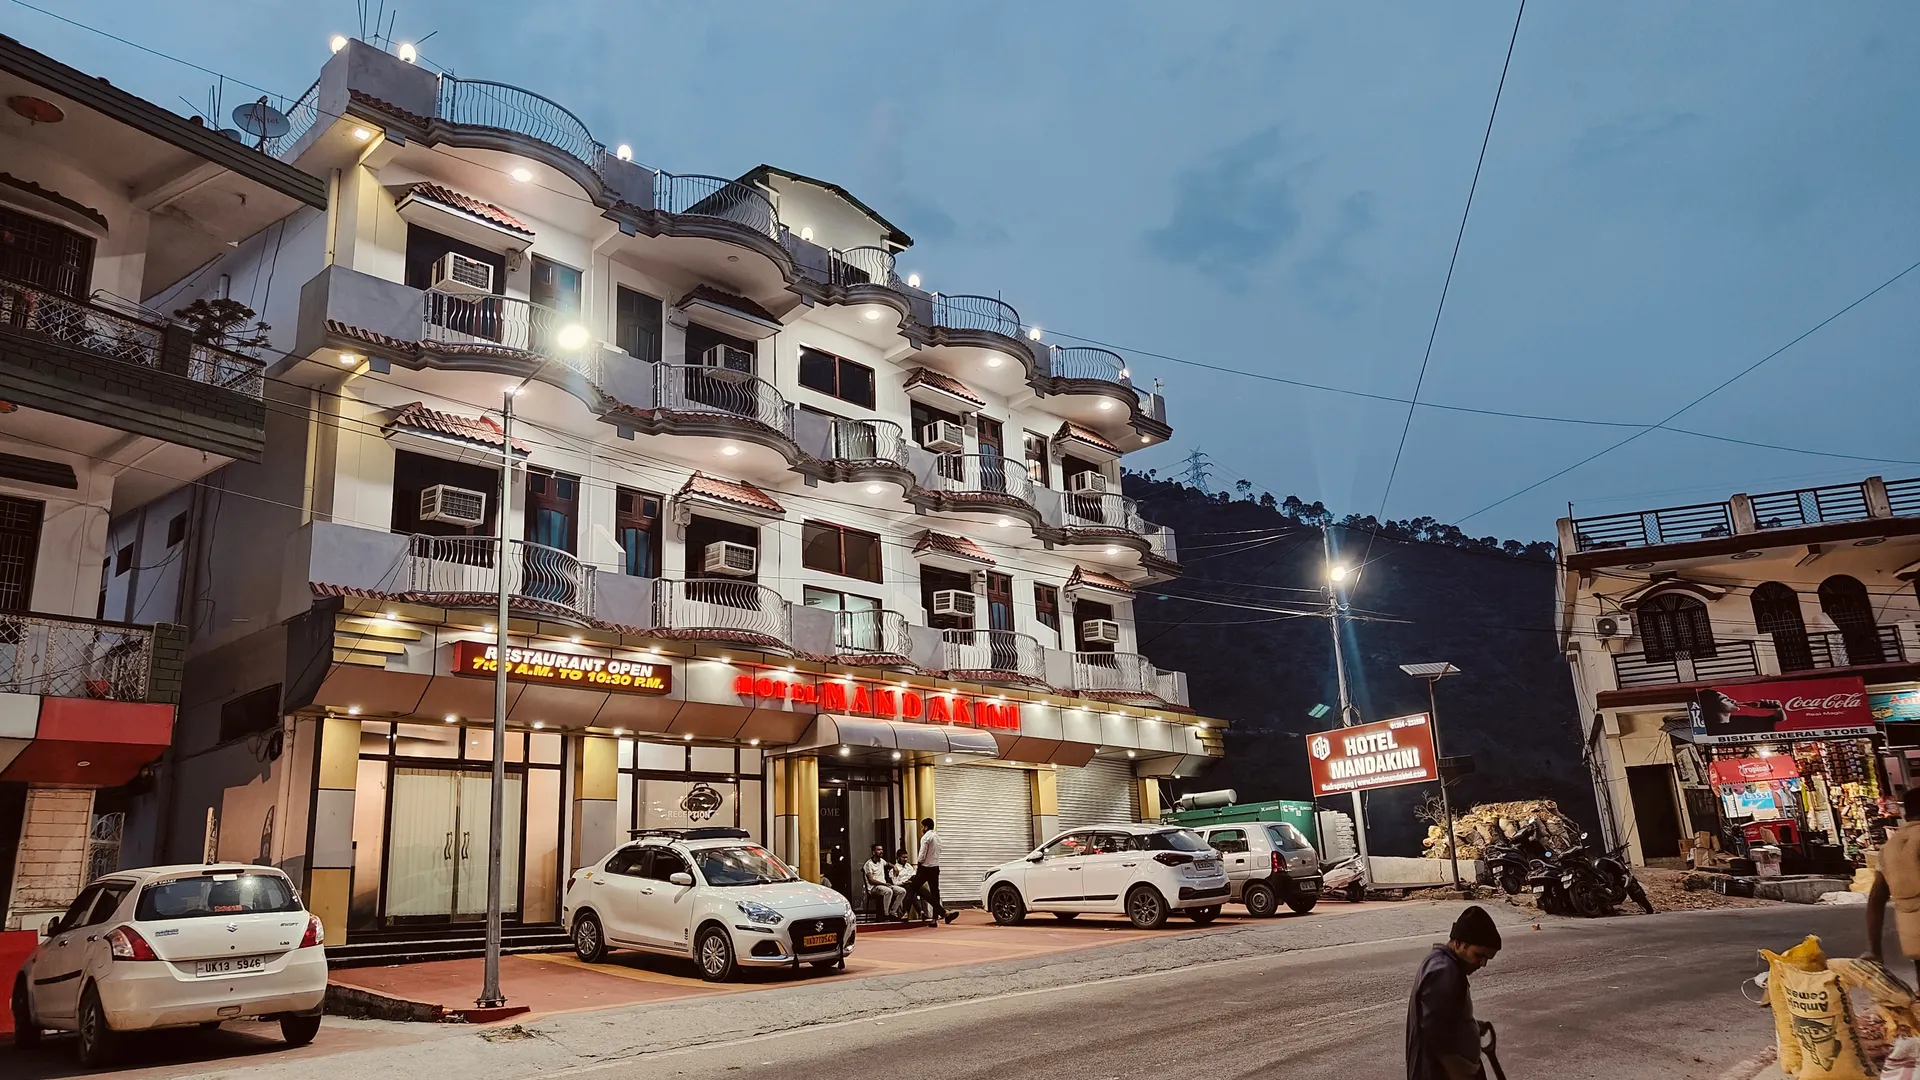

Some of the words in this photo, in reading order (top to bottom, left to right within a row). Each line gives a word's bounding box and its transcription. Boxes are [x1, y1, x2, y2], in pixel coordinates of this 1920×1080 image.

[514, 663, 554, 677] A.M.
[559, 668, 583, 680] TO
[588, 671, 631, 686] 10:30
[608, 661, 653, 677] OPEN
[735, 675, 820, 704] HOTEL
[821, 680, 1020, 731] MANDAKINI
[1785, 692, 1864, 712] Coca-Cola
[1344, 731, 1398, 757] HOTEL
[1718, 734, 1756, 743] BISHT
[1760, 731, 1819, 741] GENERAL
[1823, 728, 1868, 736] STORE
[1330, 747, 1421, 780] MANDAKINI
[667, 810, 711, 820] RECEPTION
[205, 961, 230, 972] UK13
[236, 958, 261, 970] 5946
